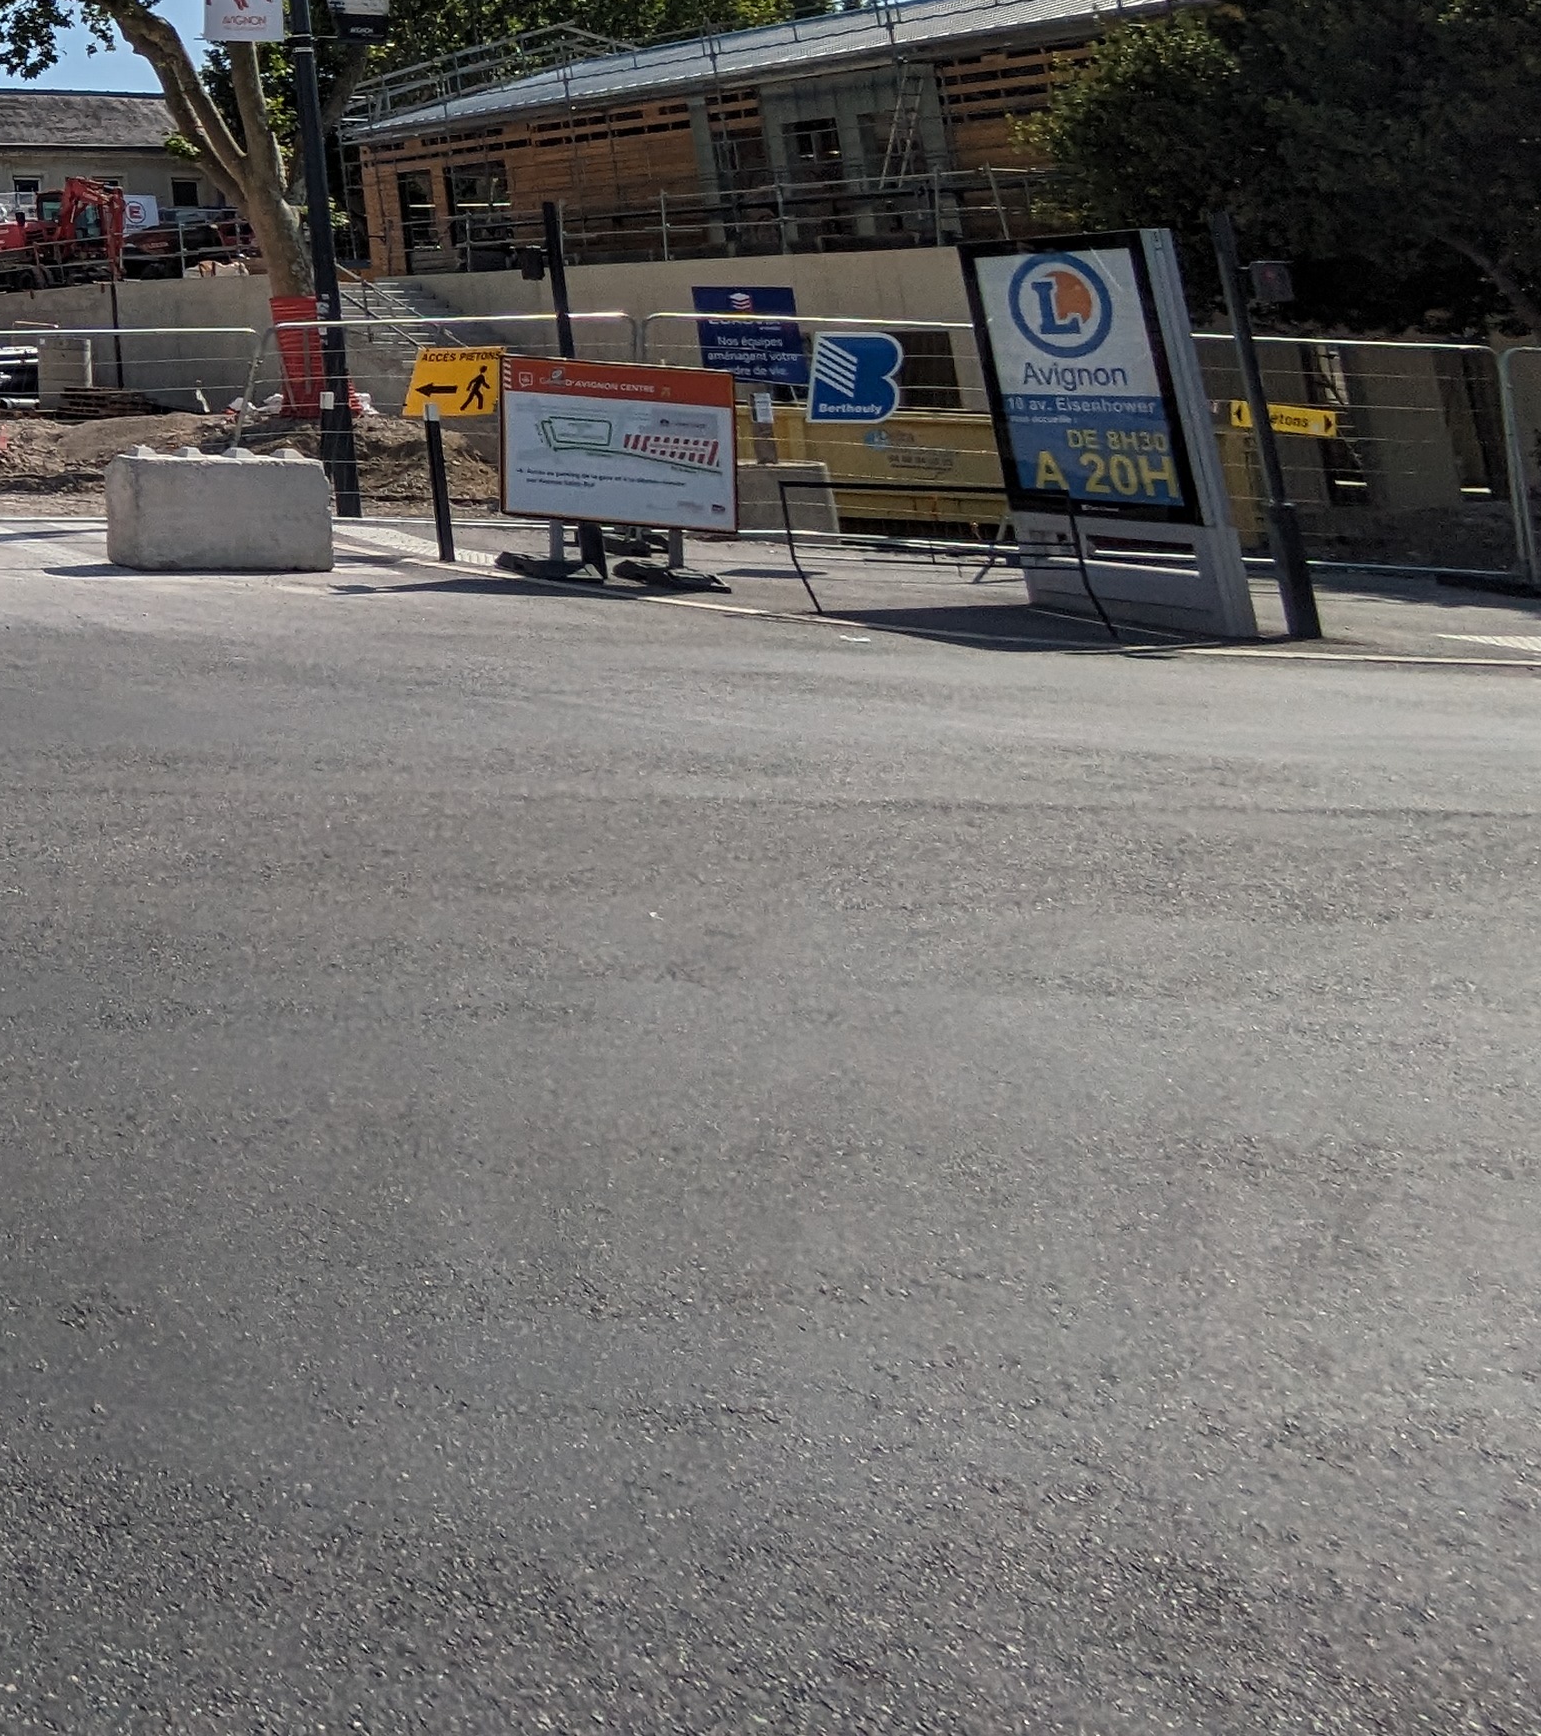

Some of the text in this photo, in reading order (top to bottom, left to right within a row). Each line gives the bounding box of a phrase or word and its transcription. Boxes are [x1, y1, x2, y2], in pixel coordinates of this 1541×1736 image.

[717, 336, 738, 346] Nos
[1023, 362, 1128, 391] Avignon
[818, 403, 882, 416] Berthouly
[1055, 397, 1156, 414] Eisenhower
[1067, 429, 1167, 453] DE 8H30
[1079, 452, 1181, 499] 20H
